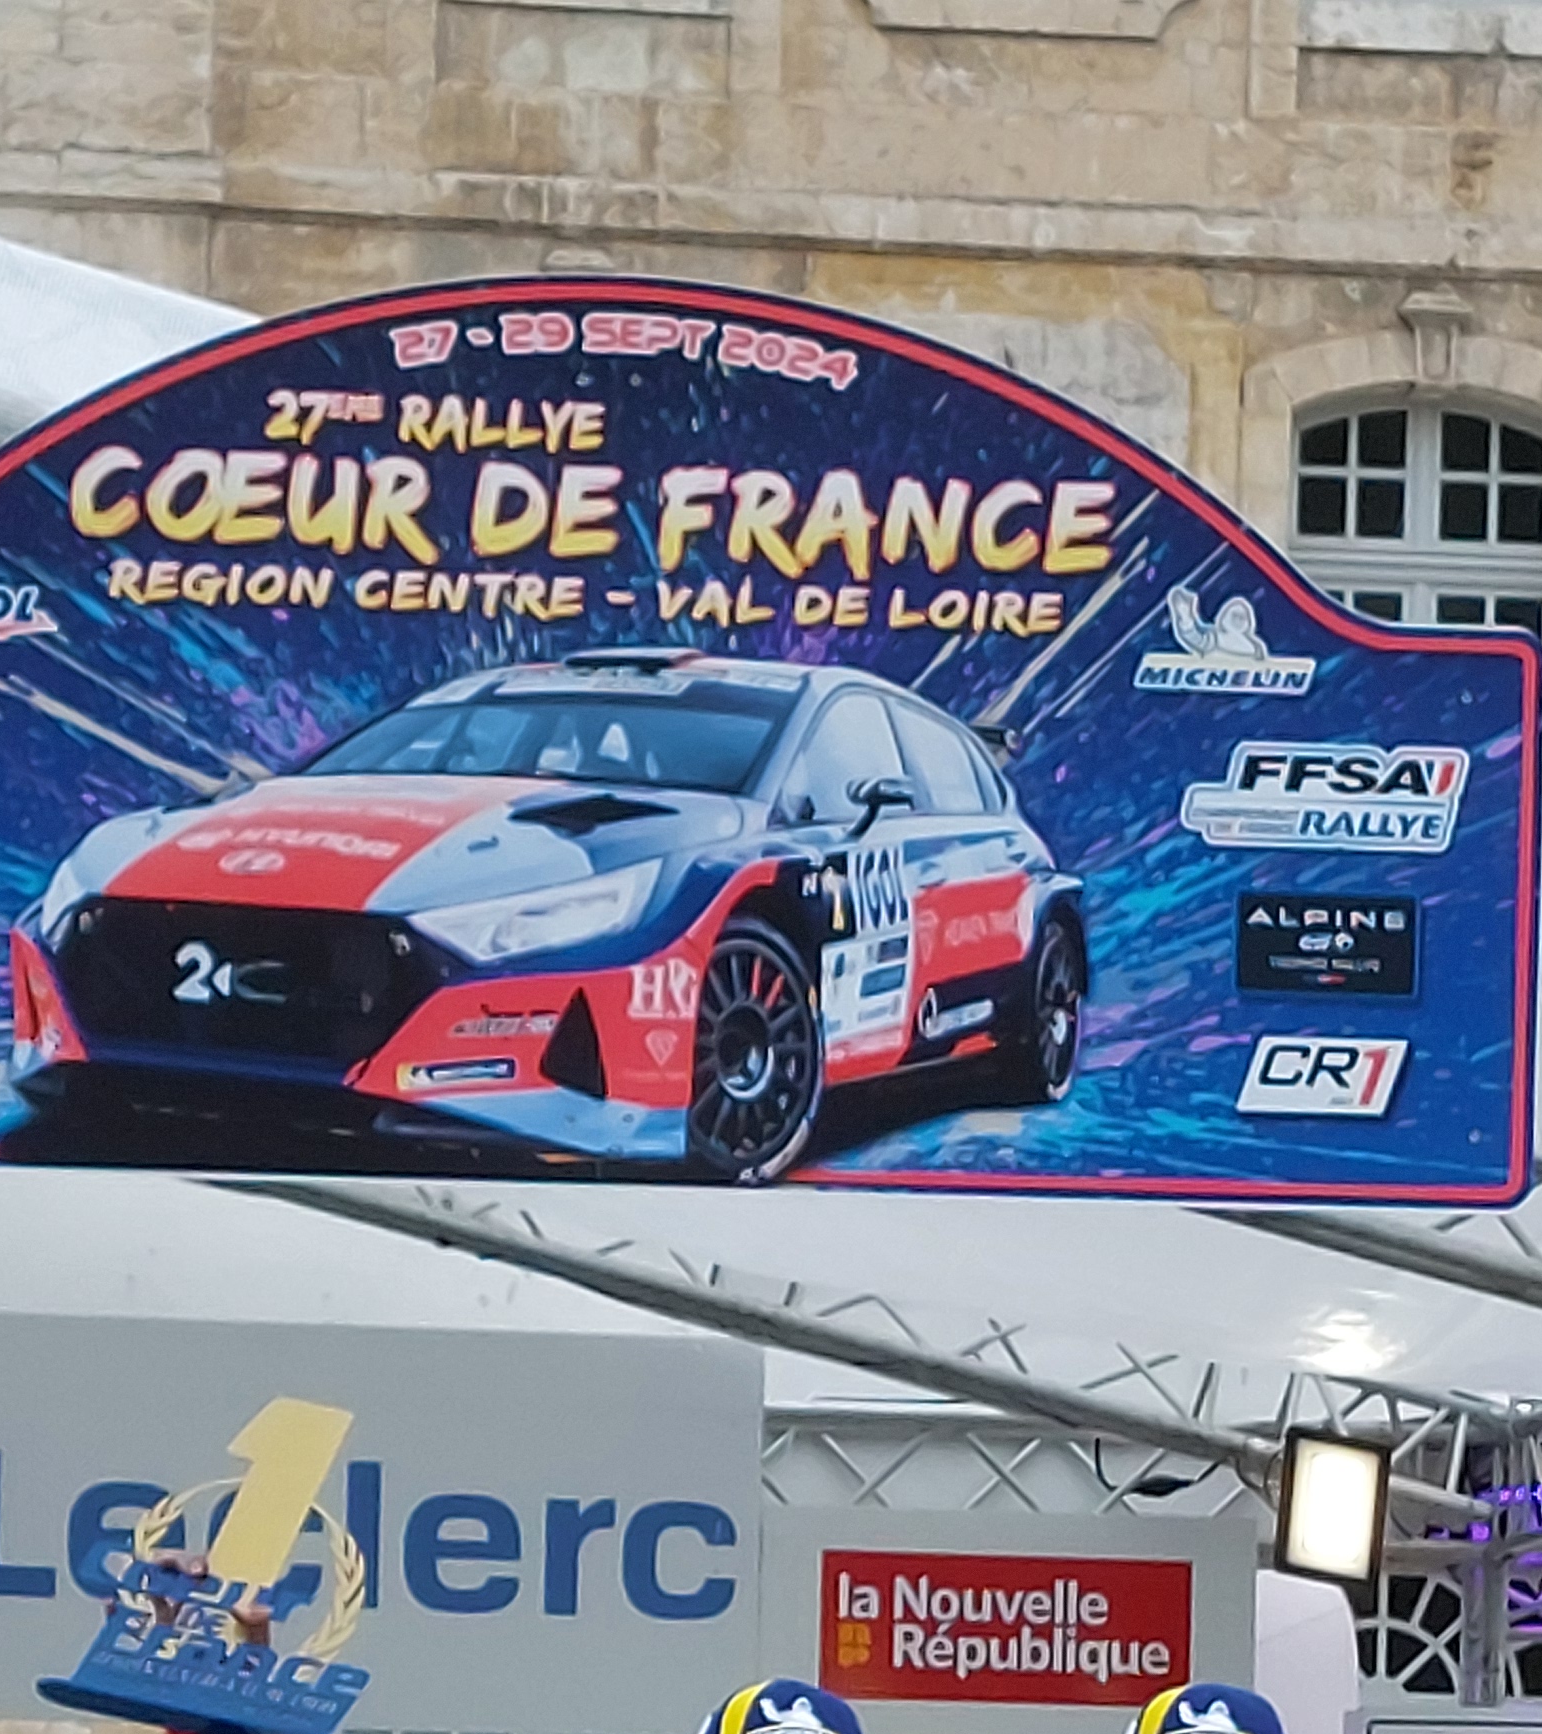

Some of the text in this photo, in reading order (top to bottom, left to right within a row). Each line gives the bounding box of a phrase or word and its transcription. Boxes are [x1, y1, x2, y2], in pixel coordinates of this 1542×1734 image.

[391, 324, 456, 369] 27
[501, 314, 573, 356] 29
[582, 312, 714, 360] SEPT
[717, 323, 858, 390] 2024
[397, 394, 607, 455] RALLYE
[469, 463, 623, 560] DE
[657, 465, 1117, 580] FRANCE
[108, 558, 331, 609] REGION
[354, 568, 584, 621] CENTRE
[657, 582, 776, 627] VAL
[793, 583, 869, 630] DE
[887, 586, 1063, 640] LOIRE
[1138, 665, 1308, 691] MICHELIN
[1237, 754, 1433, 797] FFSA
[1298, 808, 1443, 841] RALLYE
[1245, 905, 1406, 932] ALPINE
[1257, 1043, 1393, 1107] CR1
[836, 1570, 1109, 1627] la Nouvelle
[892, 1622, 1172, 1684] République
